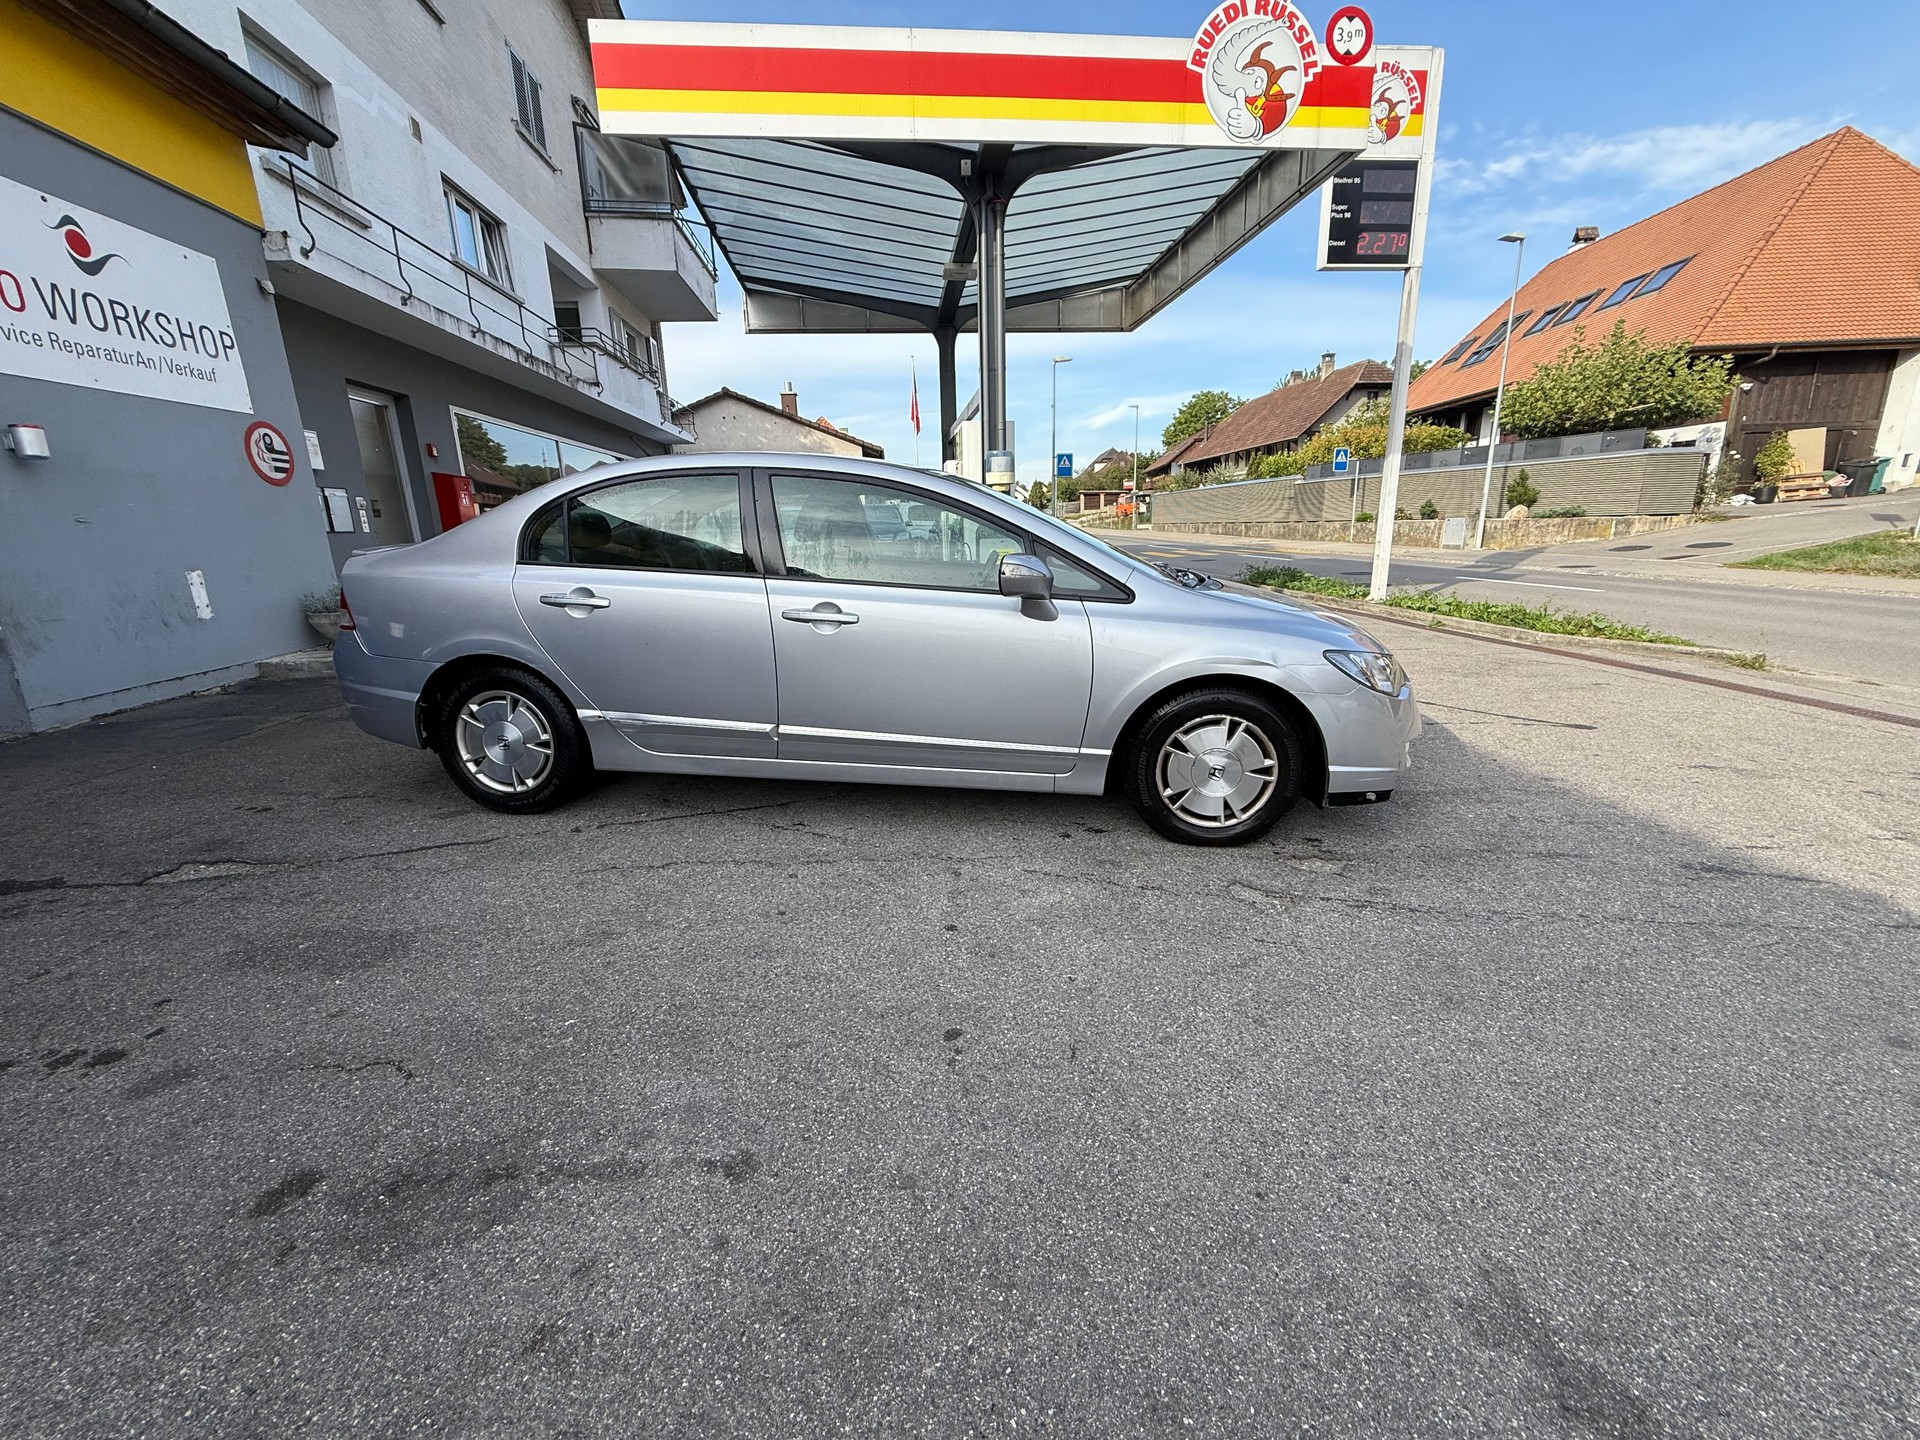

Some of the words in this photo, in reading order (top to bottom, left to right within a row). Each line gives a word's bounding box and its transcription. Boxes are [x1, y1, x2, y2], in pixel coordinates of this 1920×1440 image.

[1191, 0, 1248, 69] RUEDI
[1381, 60, 1418, 106] RÜSSEL
[1331, 203, 1348, 211] Super
[30, 276, 235, 362] WORKSHOP
